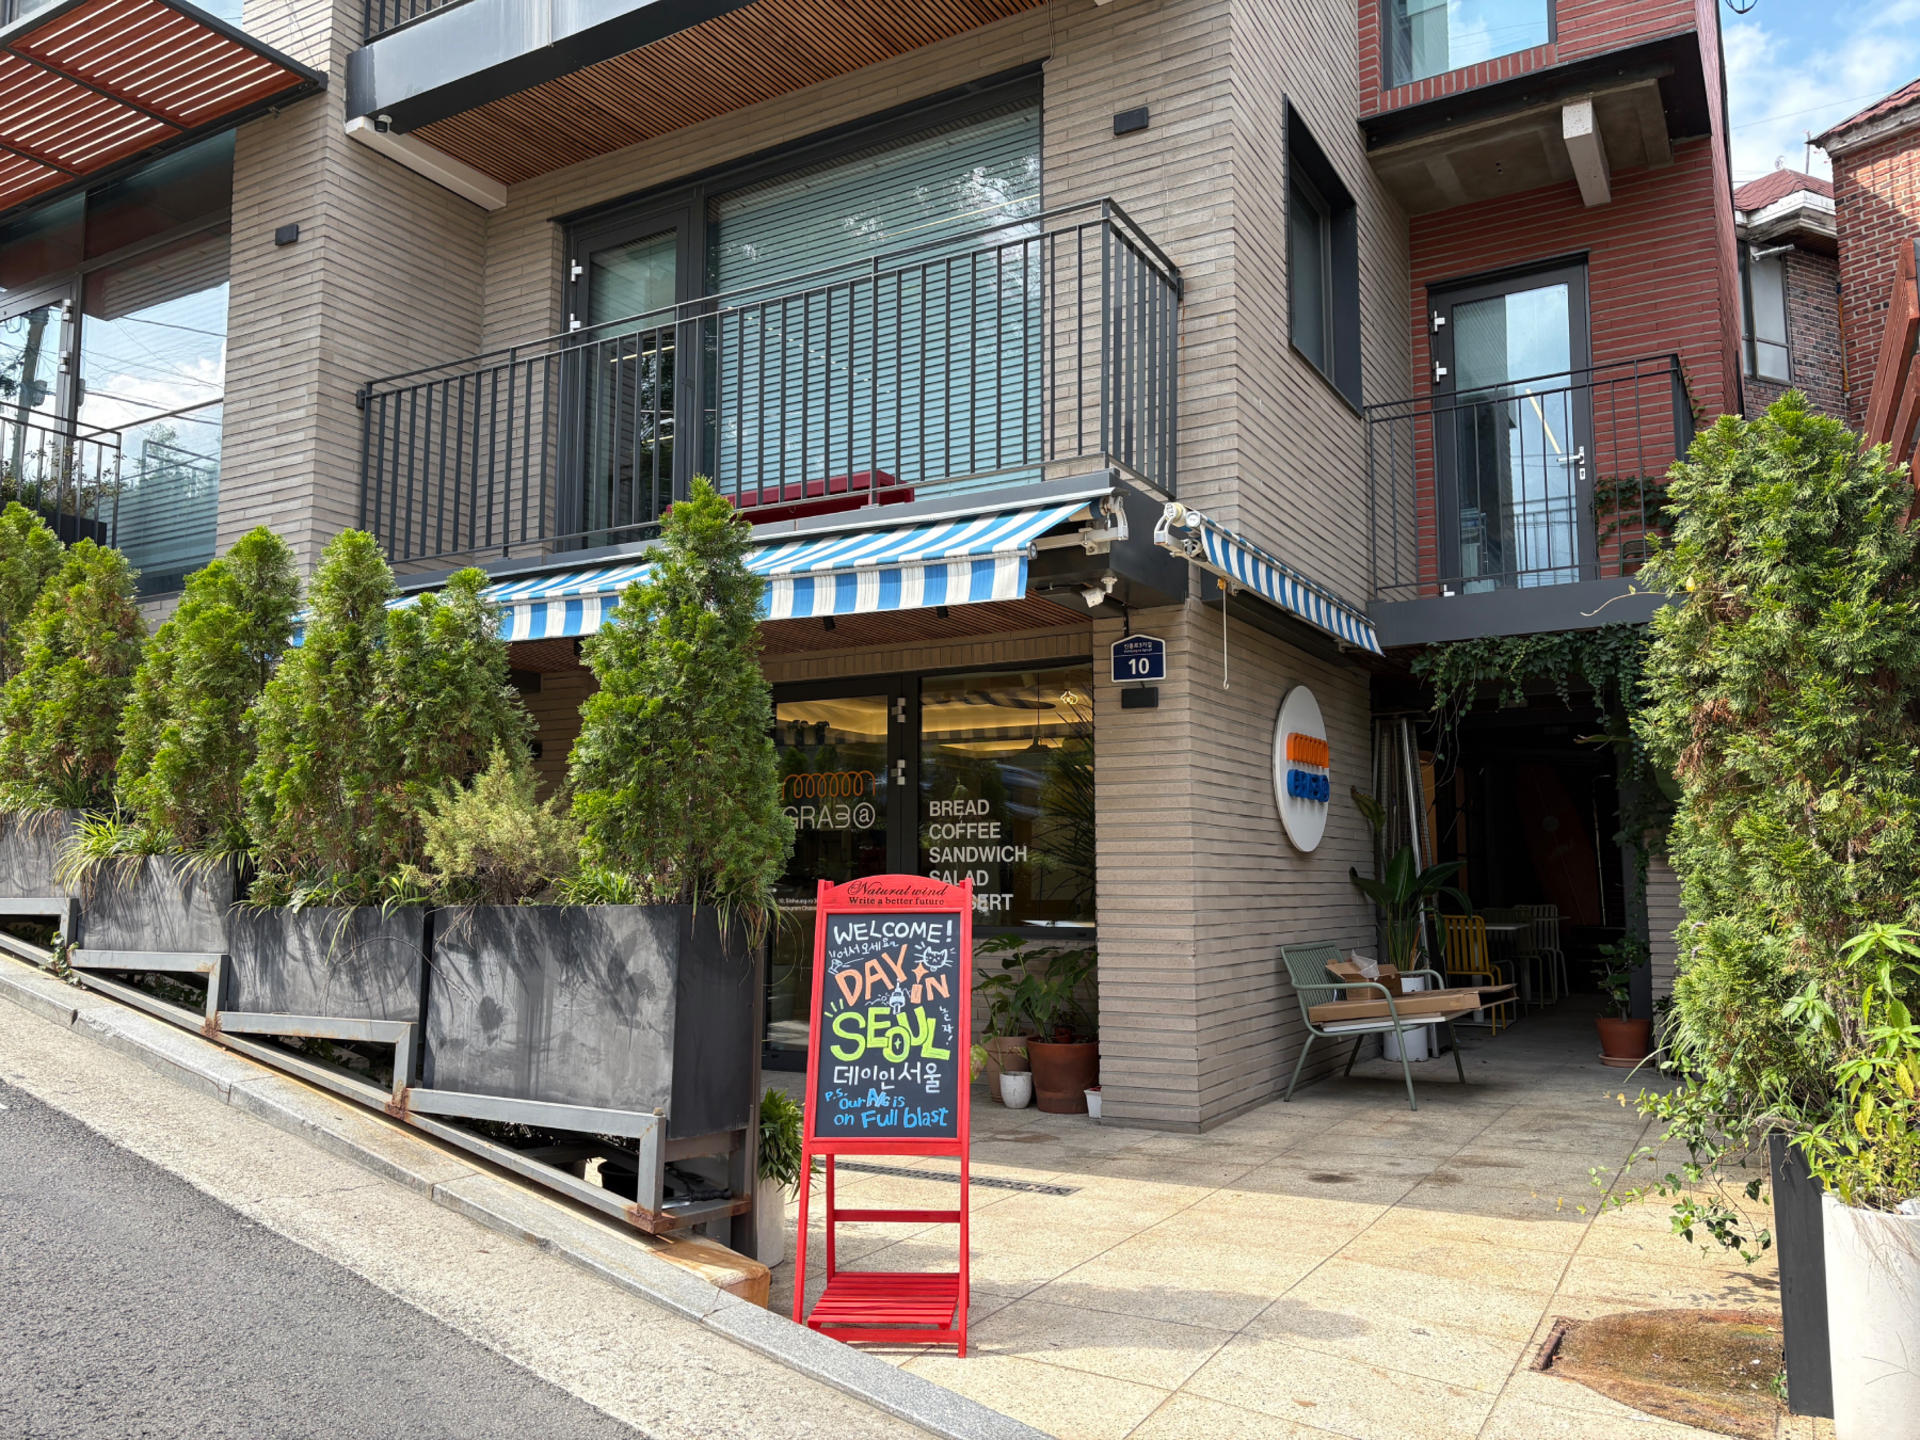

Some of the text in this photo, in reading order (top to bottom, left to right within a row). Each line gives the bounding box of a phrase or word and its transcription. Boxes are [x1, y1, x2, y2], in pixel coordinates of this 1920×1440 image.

[1128, 657, 1150, 675] 10
[929, 799, 990, 817] BREAD
[929, 822, 1001, 841] COFFEE
[929, 845, 1028, 864] SANDWICH
[847, 881, 949, 897] Natural wind
[849, 896, 876, 905] Write
[885, 897, 914, 906] better
[915, 897, 945, 906] future
[833, 919, 953, 946] WELCOME!
[834, 943, 908, 1007] DAY
[829, 1006, 951, 1063] SEOUL
[892, 1095, 906, 1108] is
[833, 1106, 949, 1129] on Full blast
